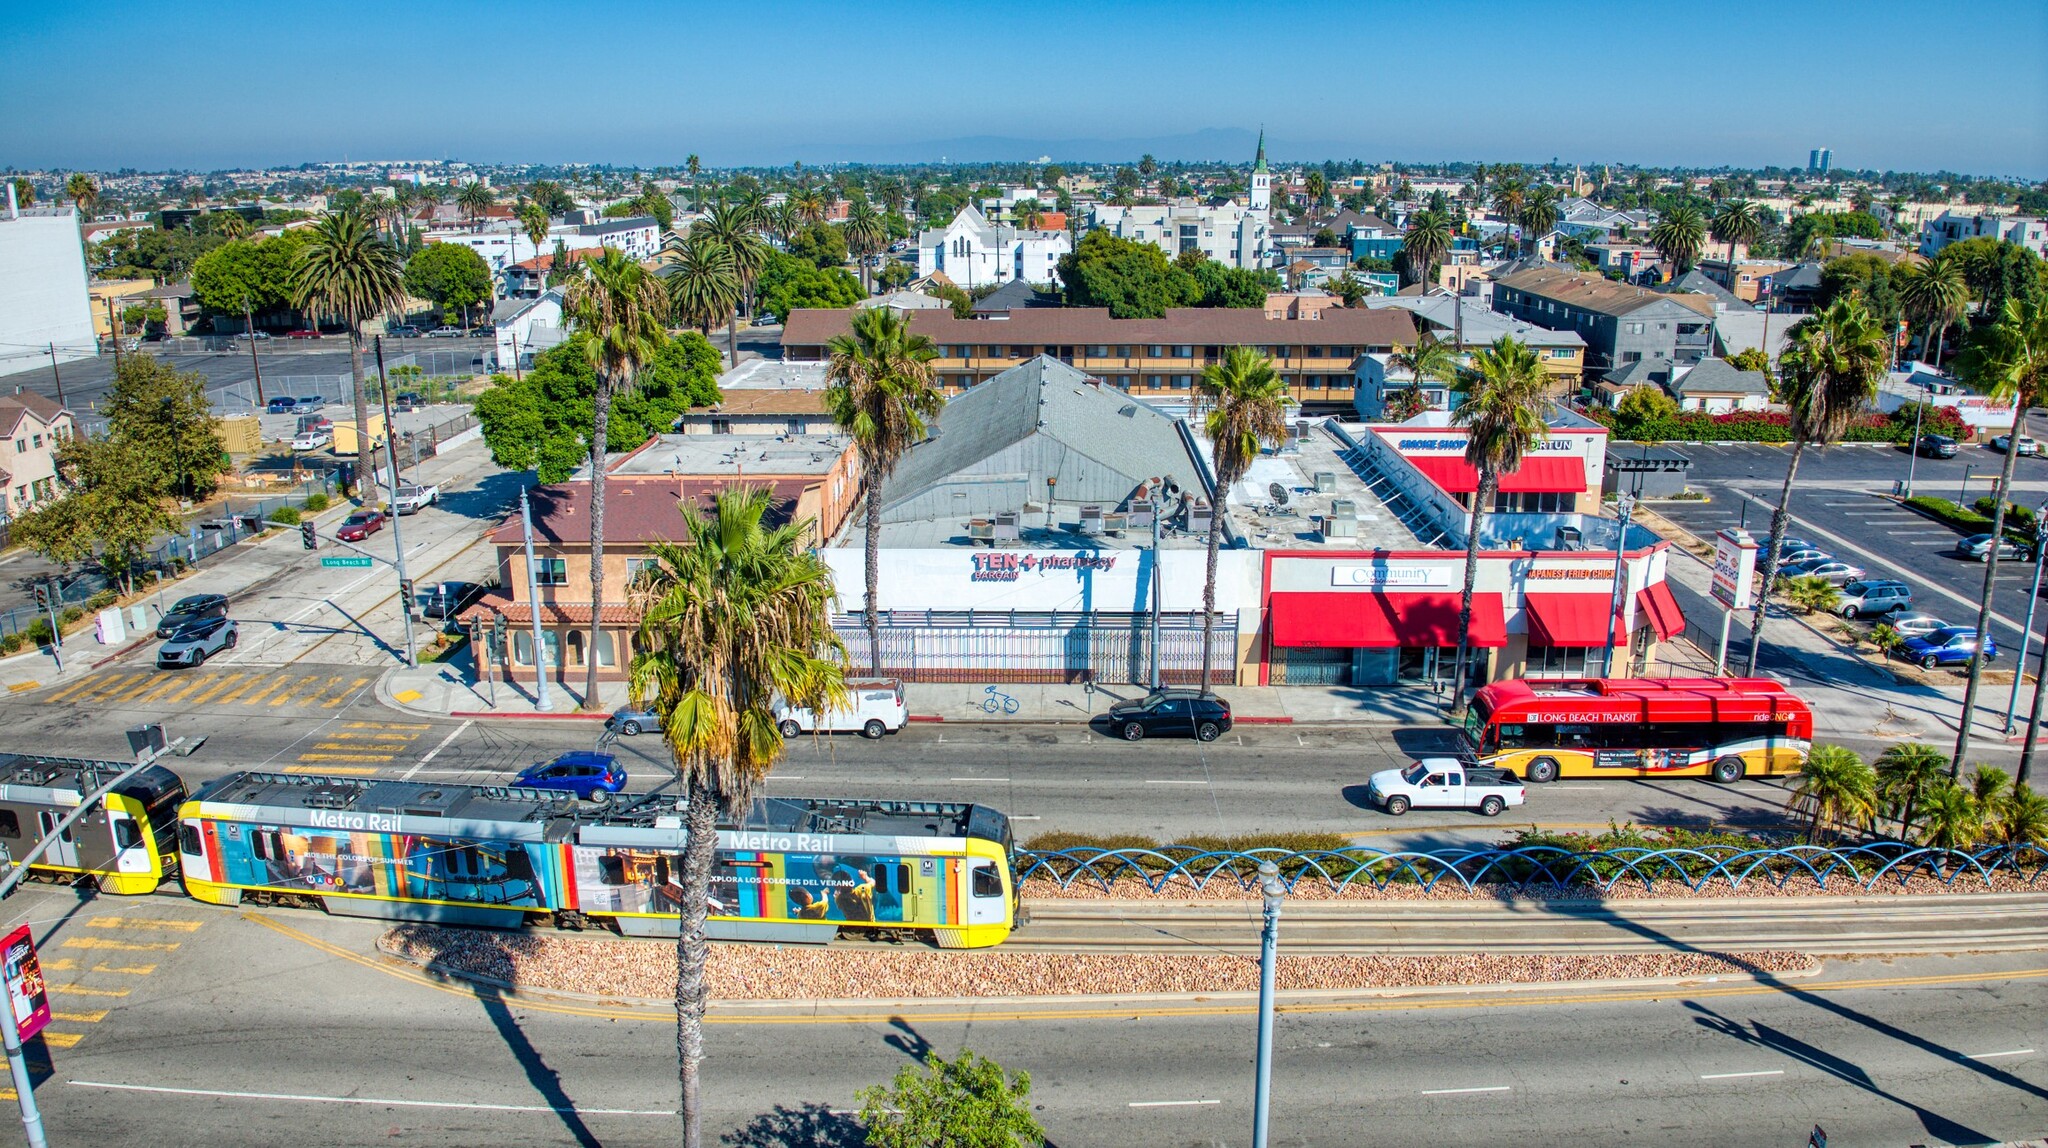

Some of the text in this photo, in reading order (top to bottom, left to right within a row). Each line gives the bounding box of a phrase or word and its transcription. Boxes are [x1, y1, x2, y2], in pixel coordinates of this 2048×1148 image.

[1399, 439, 1469, 450] SMOKE SHOP
[974, 552, 1019, 570] TEN
[974, 570, 1020, 580] BARGAIN
[1568, 569, 1591, 579] FRIED
[1592, 569, 1615, 579] CHICK
[1540, 712, 1567, 723] LONG
[1569, 712, 1600, 722] BEACH
[1602, 712, 1638, 722] TRANSIT
[310, 810, 403, 832] Metro Rail
[730, 831, 834, 852] Metro Rail
[303, 851, 320, 859] RIDE
[338, 854, 367, 863] COLORS
[380, 858, 414, 866] SUMMER
[745, 876, 762, 884] LOS
[763, 877, 801, 886] COLORES
[820, 879, 856, 887] VERANO
